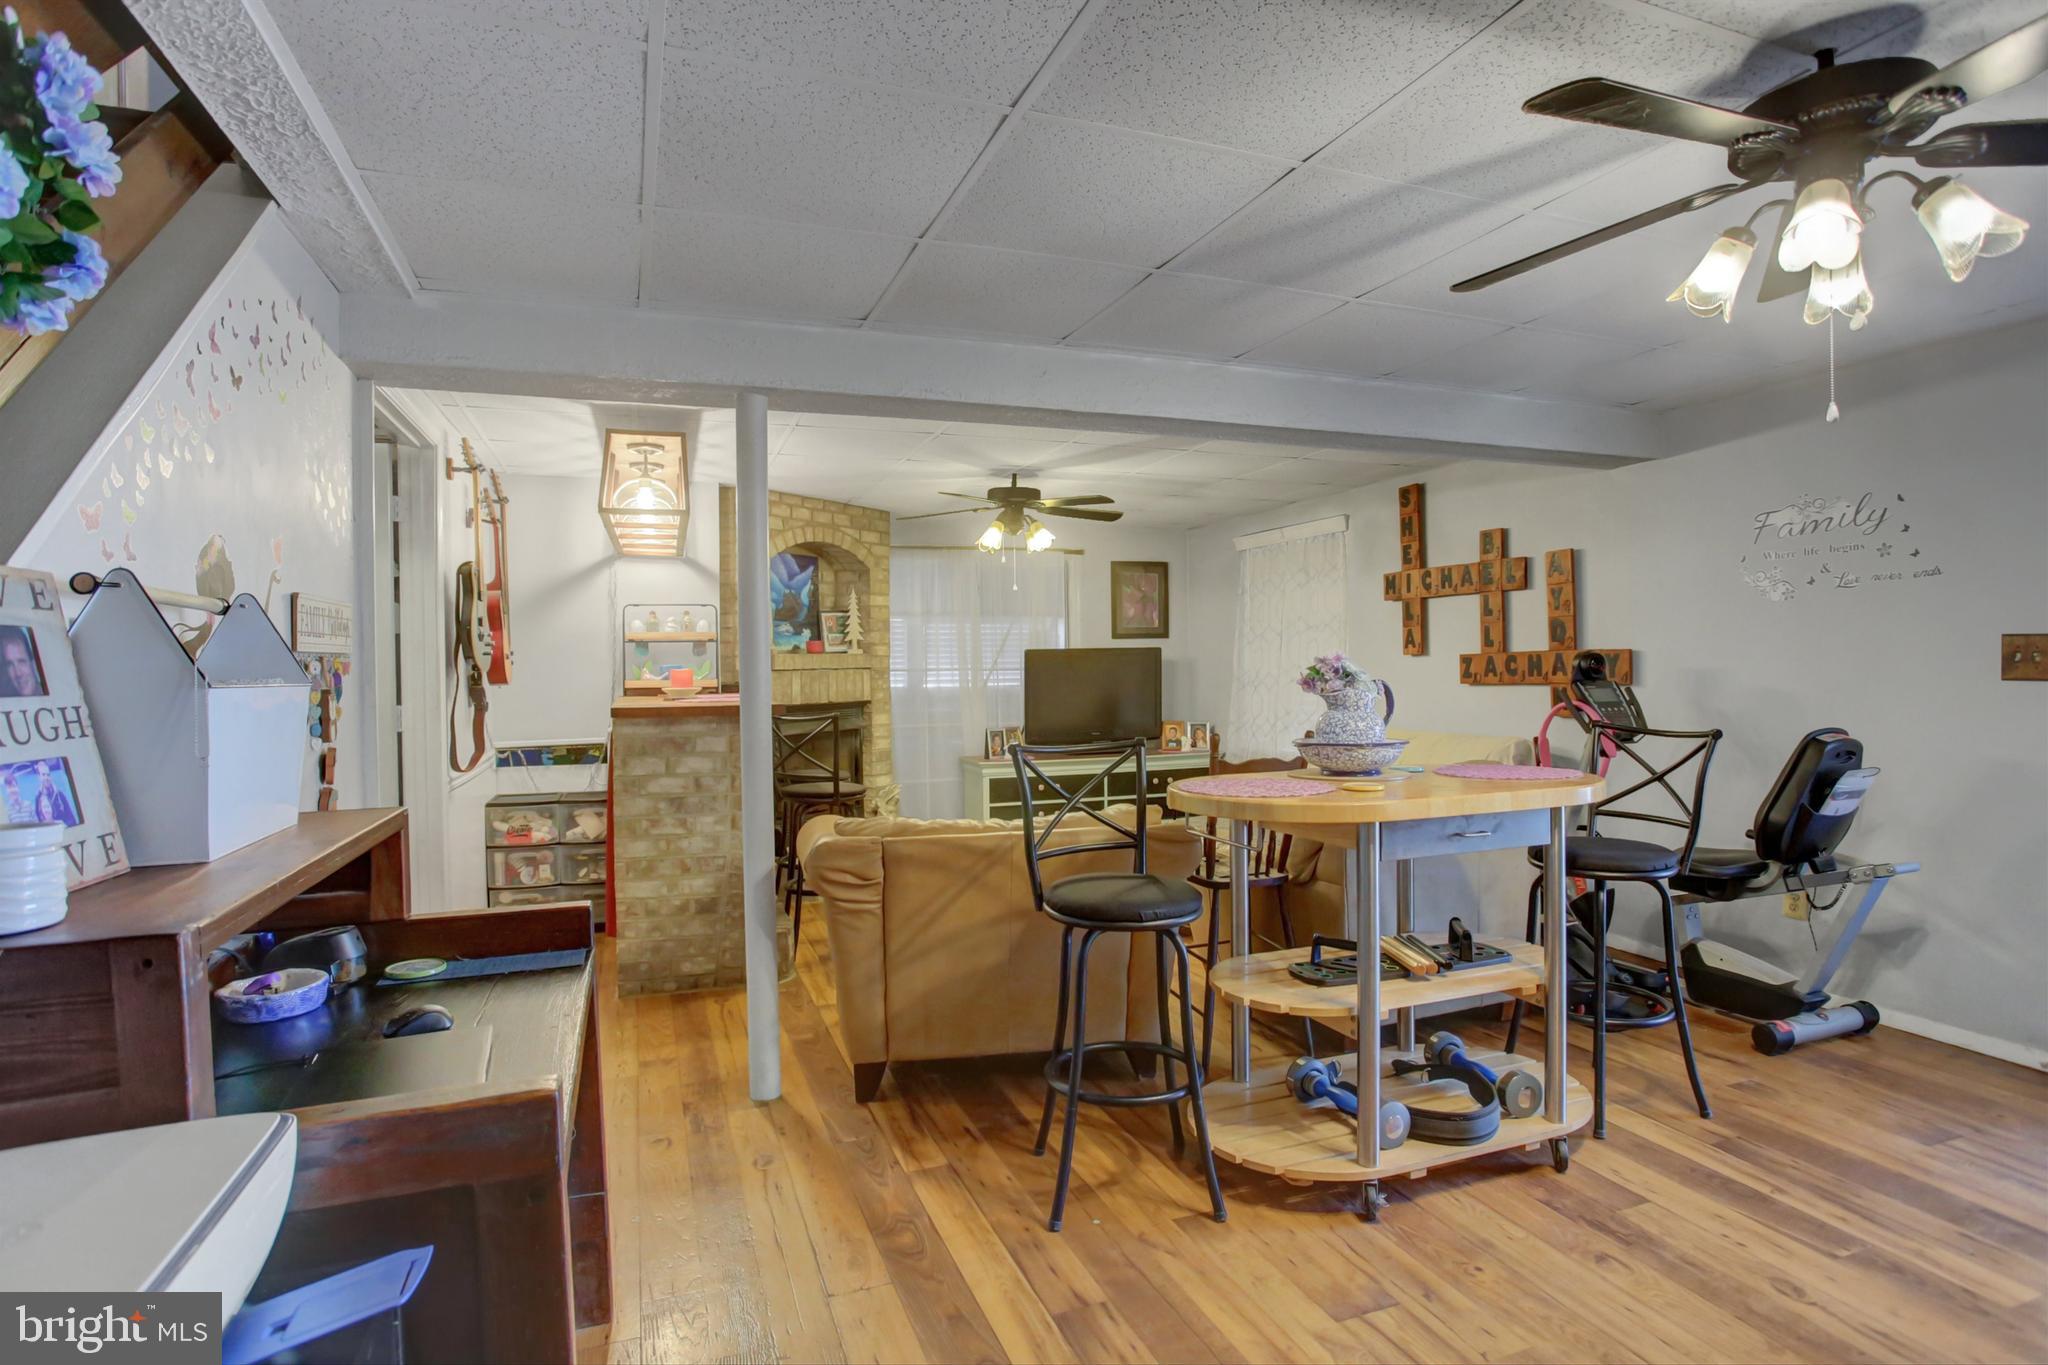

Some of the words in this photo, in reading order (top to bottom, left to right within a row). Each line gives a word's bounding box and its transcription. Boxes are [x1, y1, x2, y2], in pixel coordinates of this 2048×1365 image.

[1752, 491, 1891, 545] Family
[1400, 488, 1417, 650] SHEILA
[1763, 550, 1797, 562] Where
[1803, 547, 1820, 558] life
[1829, 543, 1866, 554] begins
[1820, 562, 1832, 574] &
[1385, 560, 1517, 595] MICHAEL
[1481, 532, 1499, 677] BELLA
[1461, 652, 1621, 679] ZACHAY
[0, 705, 90, 747] UGH
[62, 831, 122, 877] VE
